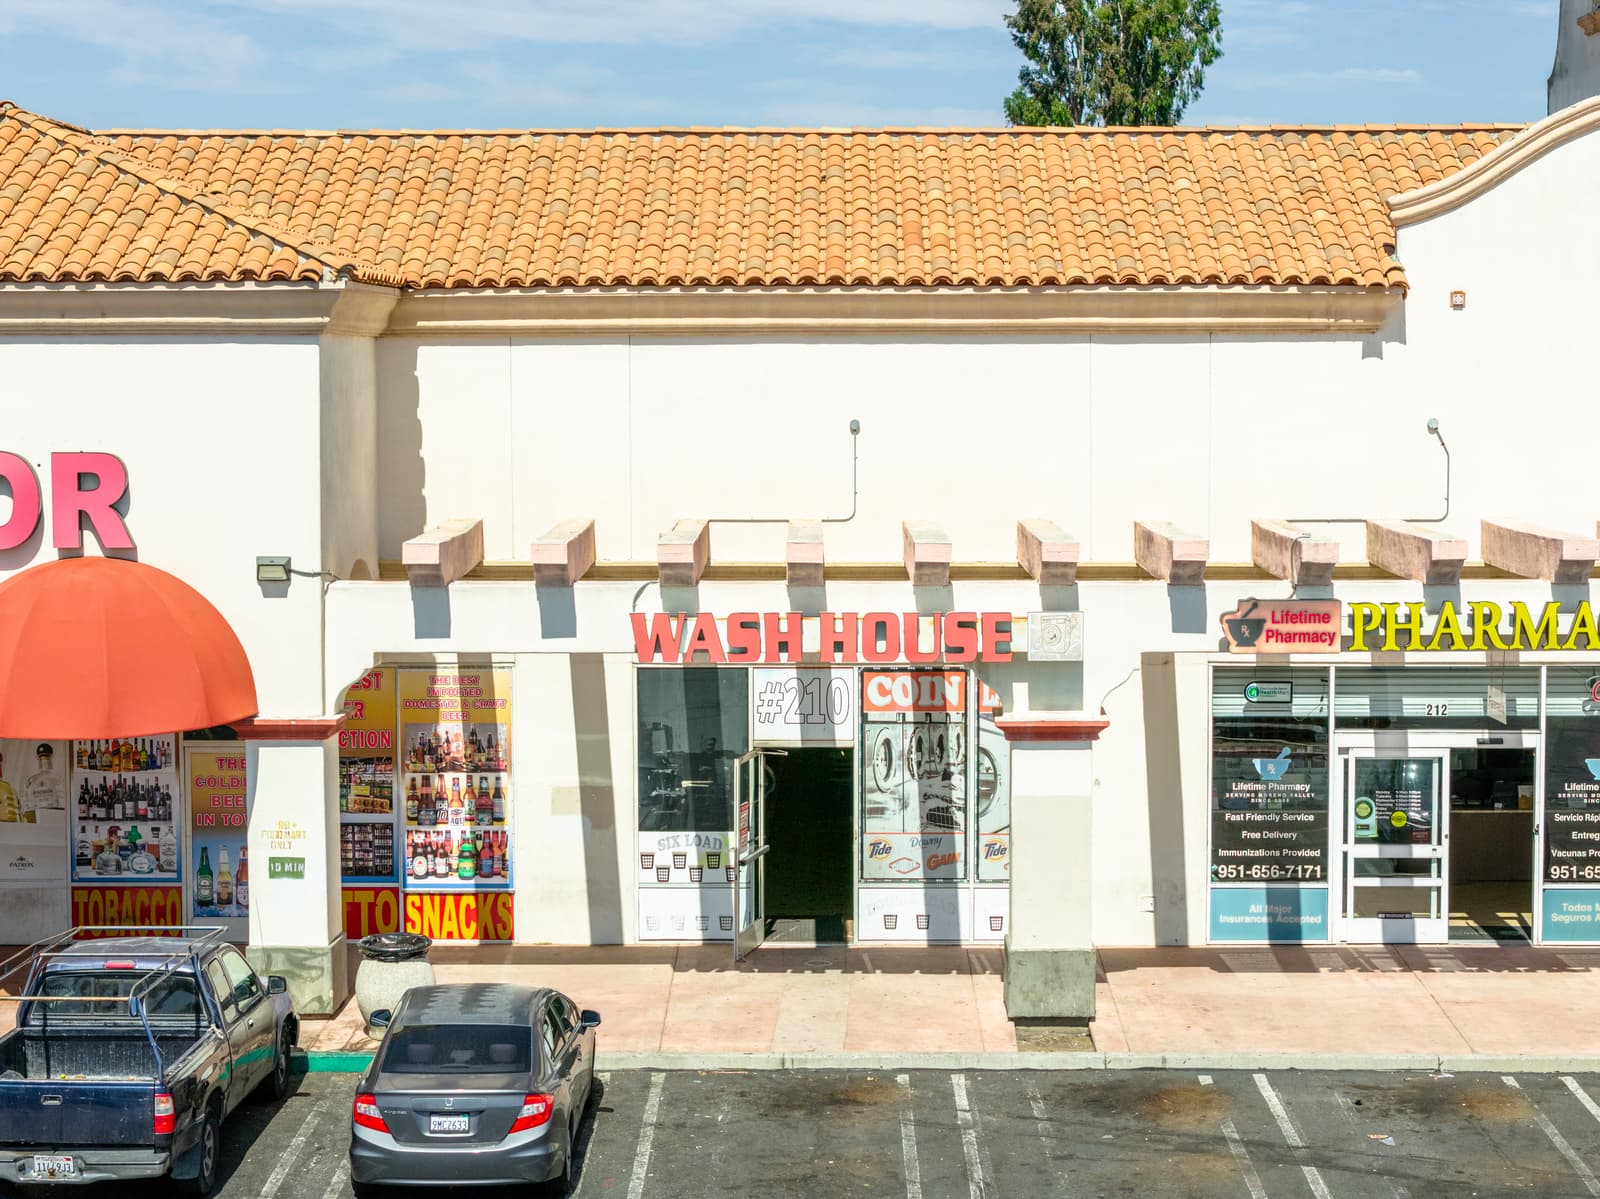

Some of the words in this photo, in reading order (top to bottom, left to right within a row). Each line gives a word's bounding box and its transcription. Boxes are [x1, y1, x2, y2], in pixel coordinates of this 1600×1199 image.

[1271, 610, 1331, 625] Lifetime
[629, 612, 803, 663] WASH
[819, 612, 1013, 663] HOUSE
[1265, 629, 1336, 646] Pharmacy
[430, 675, 450, 685] THE
[454, 675, 480, 685] BEST
[427, 687, 483, 697] IMPORTED
[867, 675, 961, 707] COIN
[403, 699, 459, 709] DOMESTIC
[461, 699, 469, 709] &
[473, 699, 507, 709] CRAFT
[756, 677, 850, 725] #210
[1426, 704, 1448, 716] 212
[441, 711, 470, 721] BEER
[1232, 782, 1267, 791] Lifetime
[1268, 782, 1311, 793] Pharmacy
[1564, 782, 1600, 791] Lifetime
[196, 813, 215, 827] IN
[1225, 813, 1244, 821] Fast
[1245, 813, 1281, 822] Friendly
[1282, 813, 1315, 821] Service
[1554, 813, 1584, 822] Servicio
[1241, 831, 1261, 839] Free
[1262, 831, 1297, 841] Delivery
[1571, 831, 1600, 841] Entreg
[657, 835, 681, 851] SIX
[685, 834, 723, 849] LOAD
[869, 840, 893, 859] Tide
[983, 842, 1008, 860] Tide
[1218, 848, 1280, 857] Immunizations
[1282, 848, 1321, 857] Provided
[1551, 849, 1587, 857] Vacunas
[270, 862, 281, 873] 10
[284, 862, 305, 873] MIN
[1218, 864, 1322, 879] 951-656-7171
[74, 888, 182, 938] TOBACCO
[1249, 904, 1263, 913] All
[1264, 904, 1293, 915] Major
[1562, 903, 1593, 912] Todos
[405, 894, 514, 940] SNACKS
[1219, 914, 1273, 924] Insurances
[1275, 914, 1322, 925] Accepted
[1551, 912, 1592, 924] Seguros
